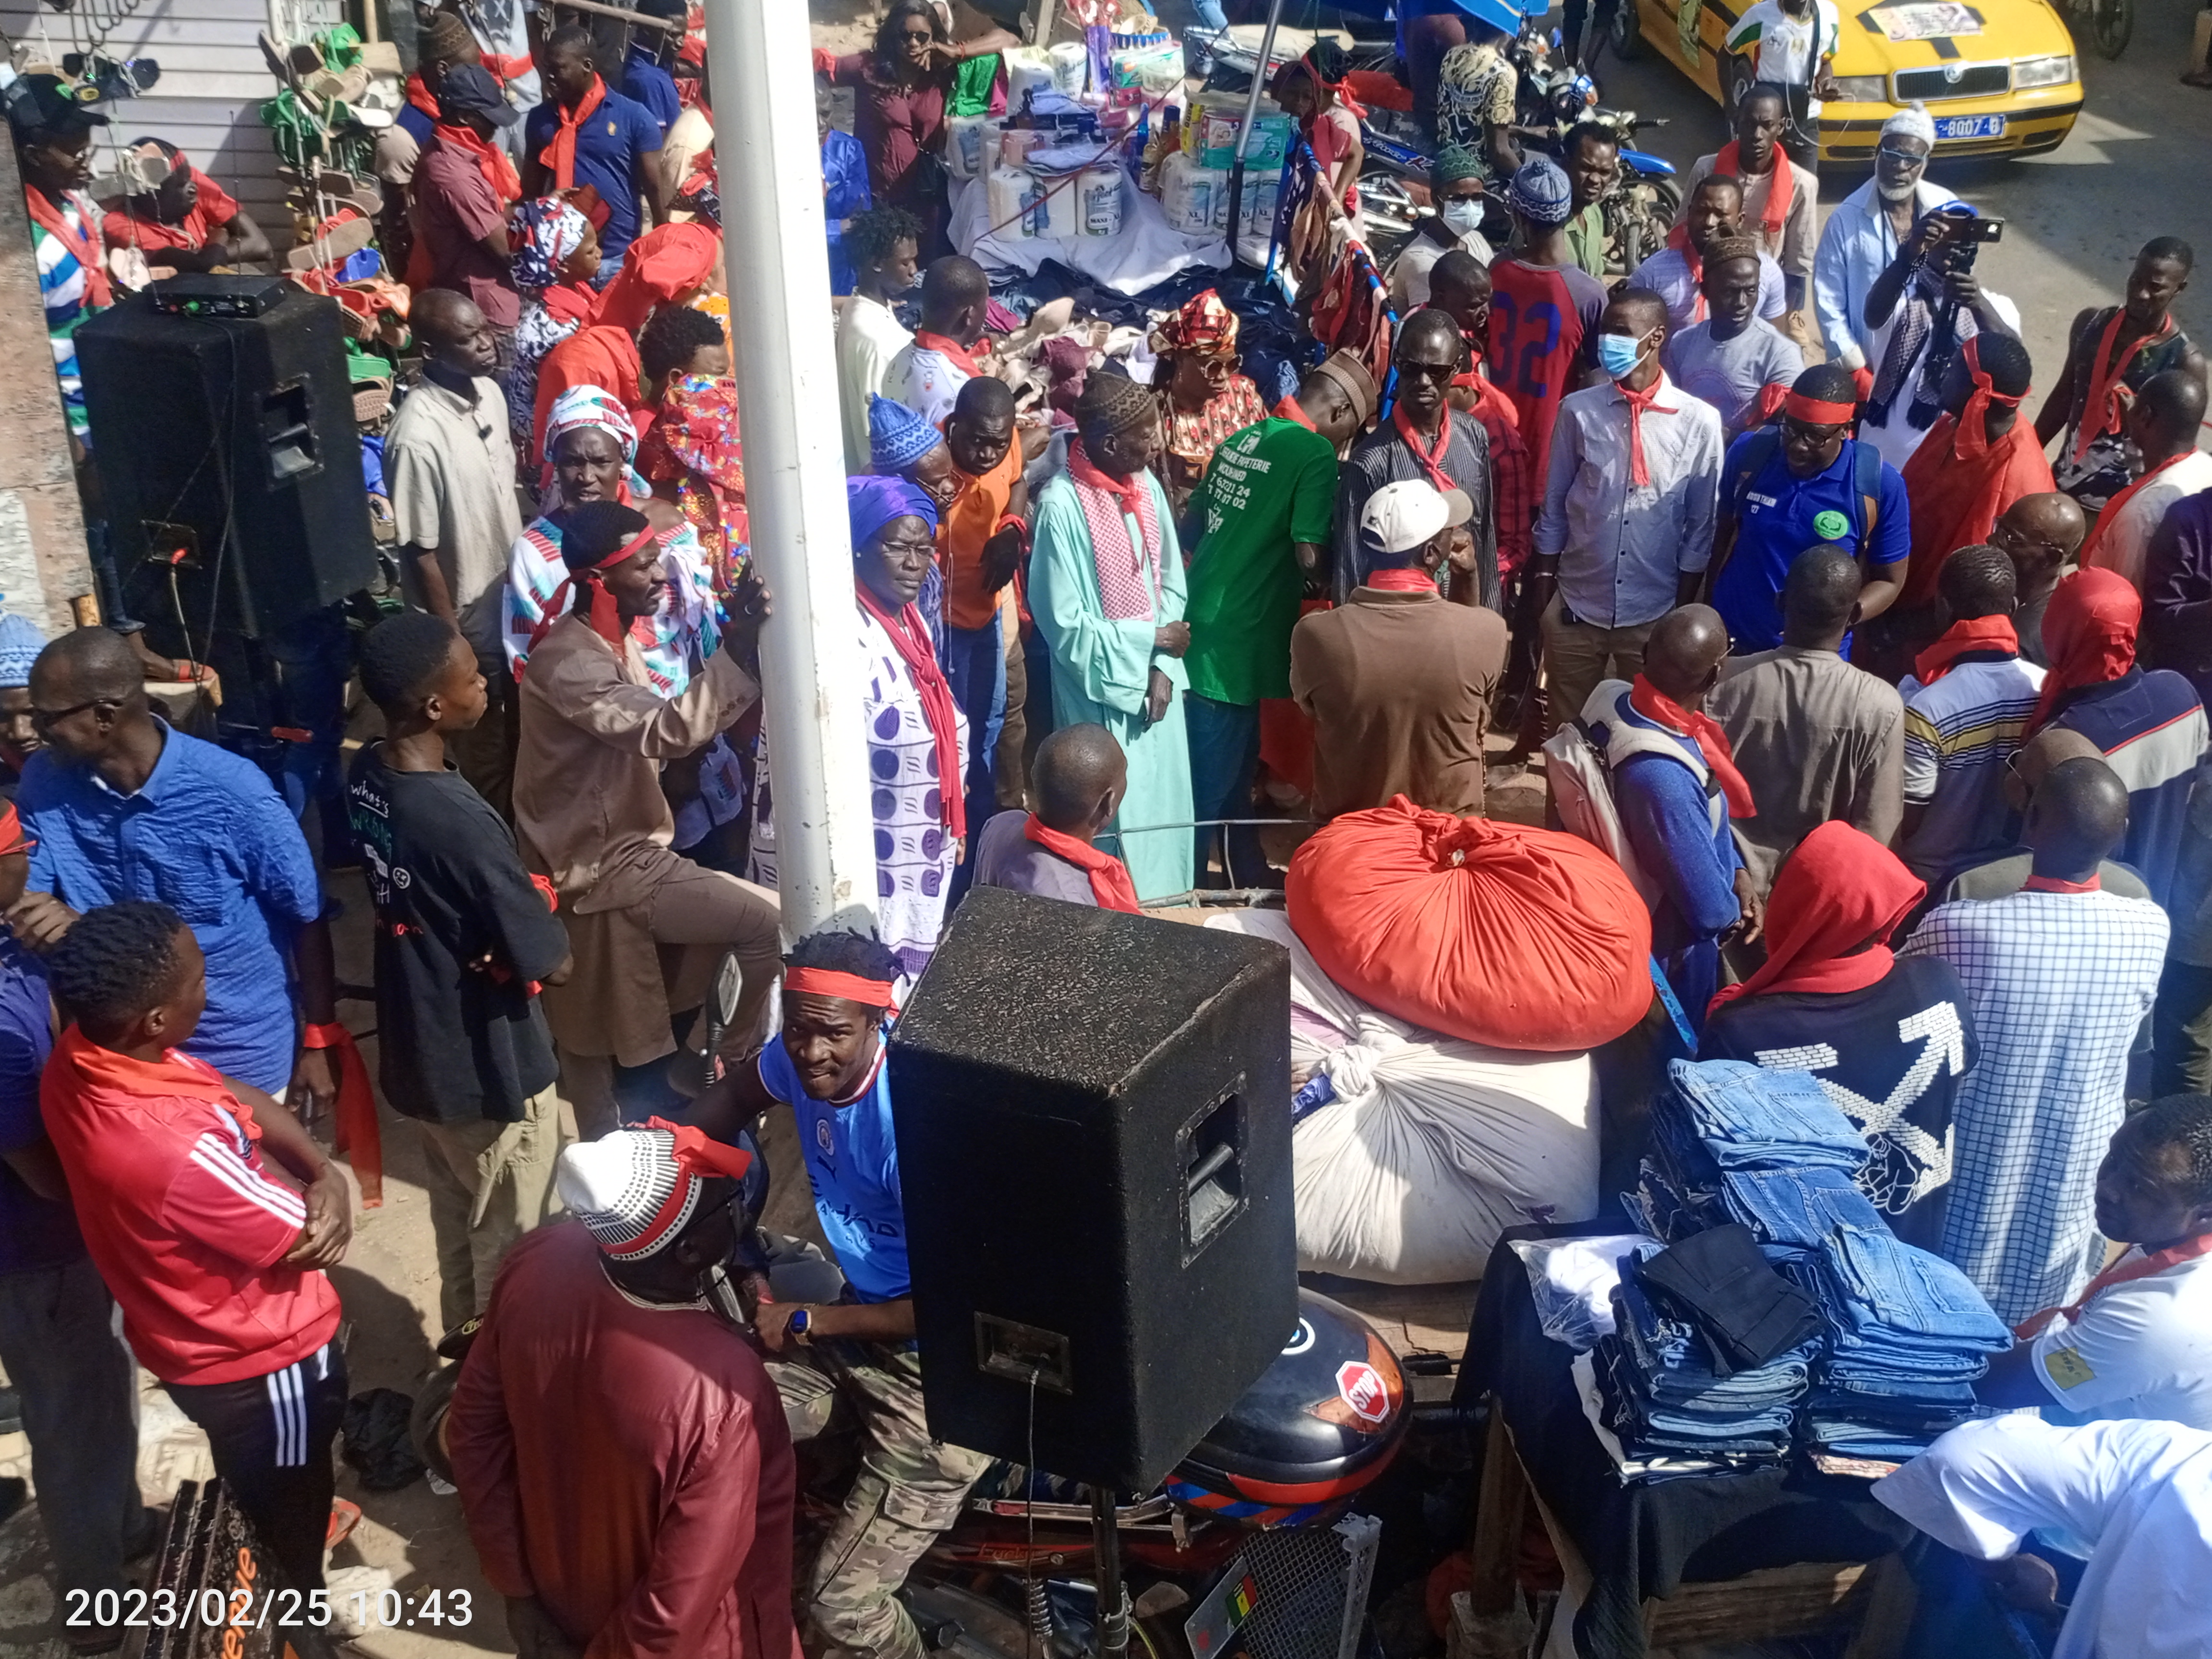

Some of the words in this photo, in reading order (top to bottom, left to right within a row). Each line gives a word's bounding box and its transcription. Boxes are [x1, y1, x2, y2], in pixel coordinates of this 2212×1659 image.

[1488, 289, 1562, 398] 32
[1232, 497, 1246, 510] 02
[1237, 485, 1250, 498] 24
[1348, 1370, 1379, 1410] STOP
